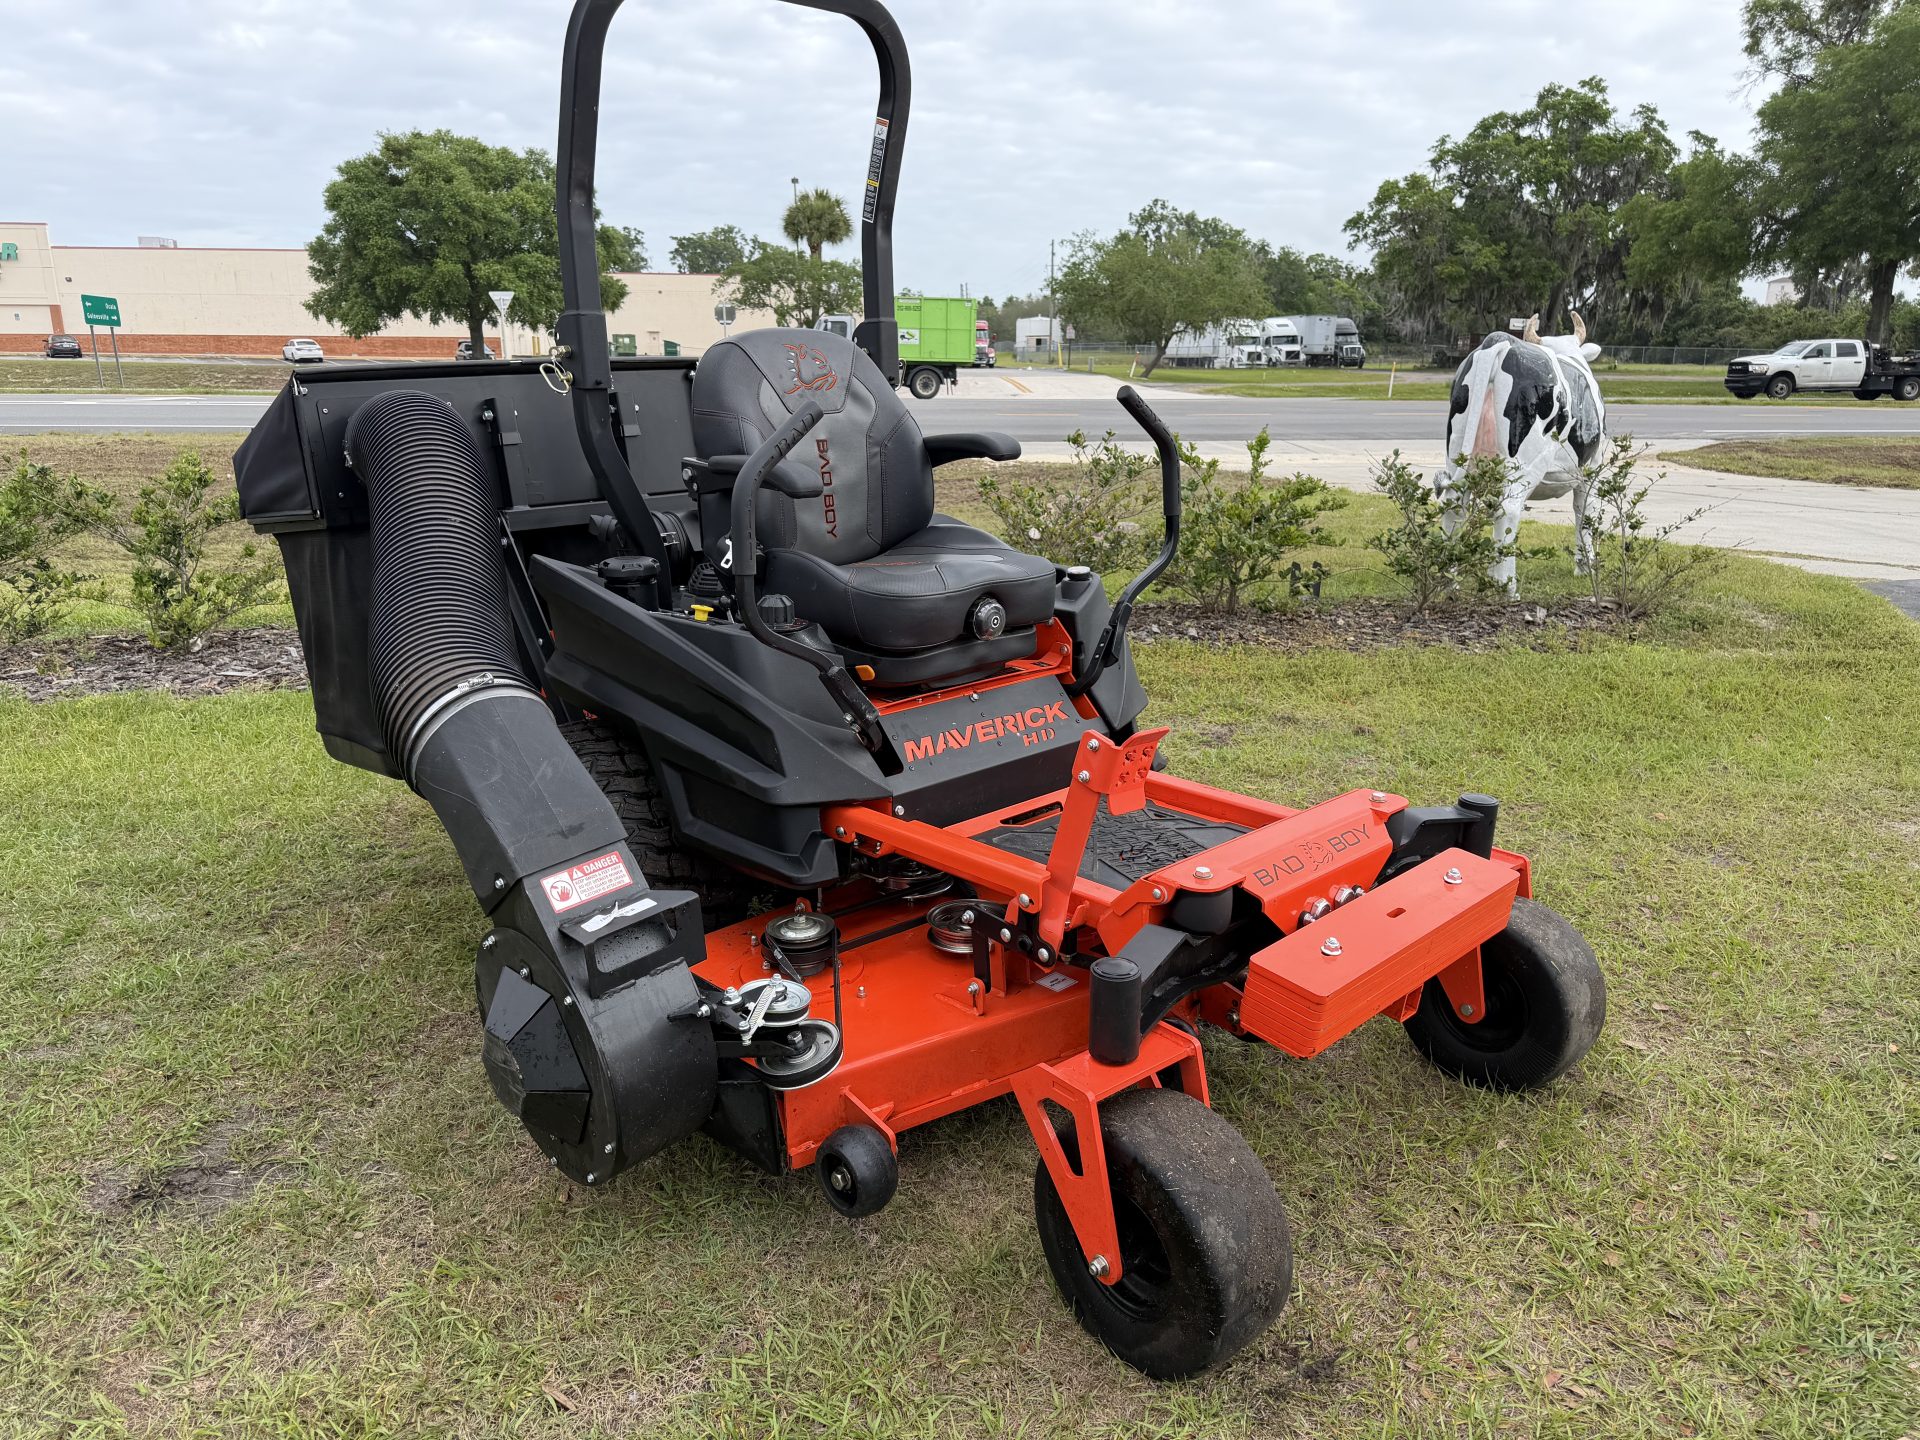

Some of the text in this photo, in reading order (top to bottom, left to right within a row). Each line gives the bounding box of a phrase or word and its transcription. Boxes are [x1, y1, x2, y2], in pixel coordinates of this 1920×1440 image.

[815, 438, 838, 539] BAD BOY
[903, 701, 1069, 763] MAVERICK
[1022, 728, 1056, 747] HD
[583, 855, 619, 874] DANGER
[1253, 823, 1370, 887] BAD BOY
